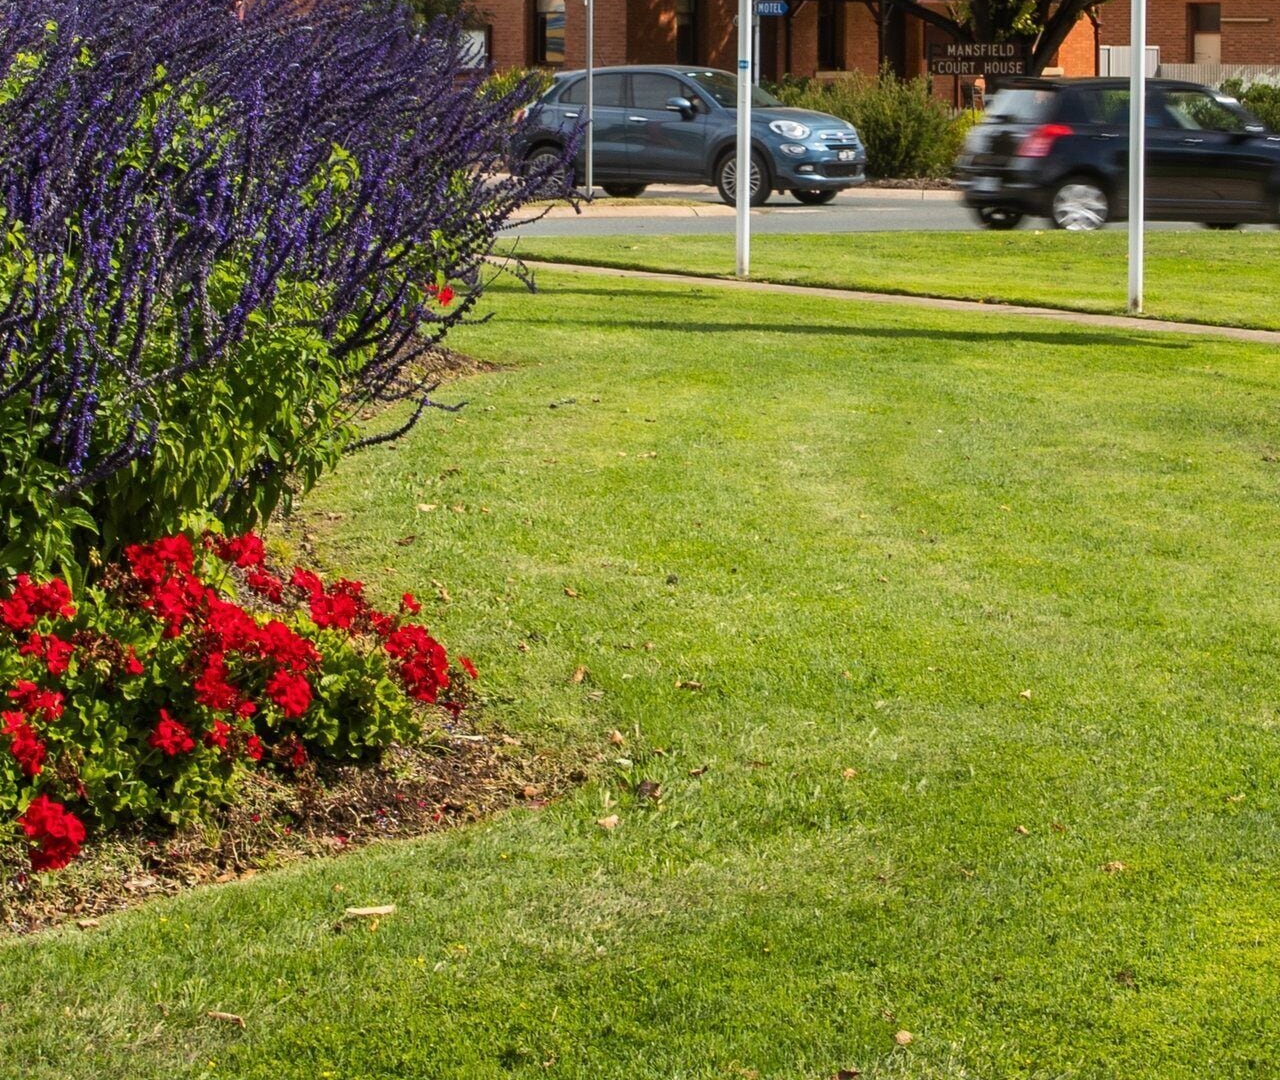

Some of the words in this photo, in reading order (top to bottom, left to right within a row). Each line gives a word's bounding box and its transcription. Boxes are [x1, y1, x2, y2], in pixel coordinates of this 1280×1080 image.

[758, 3, 782, 13] MOTEL
[947, 44, 1015, 56] MANSFIELD
[938, 61, 975, 74] COURT
[984, 61, 1023, 74] HOUSE
